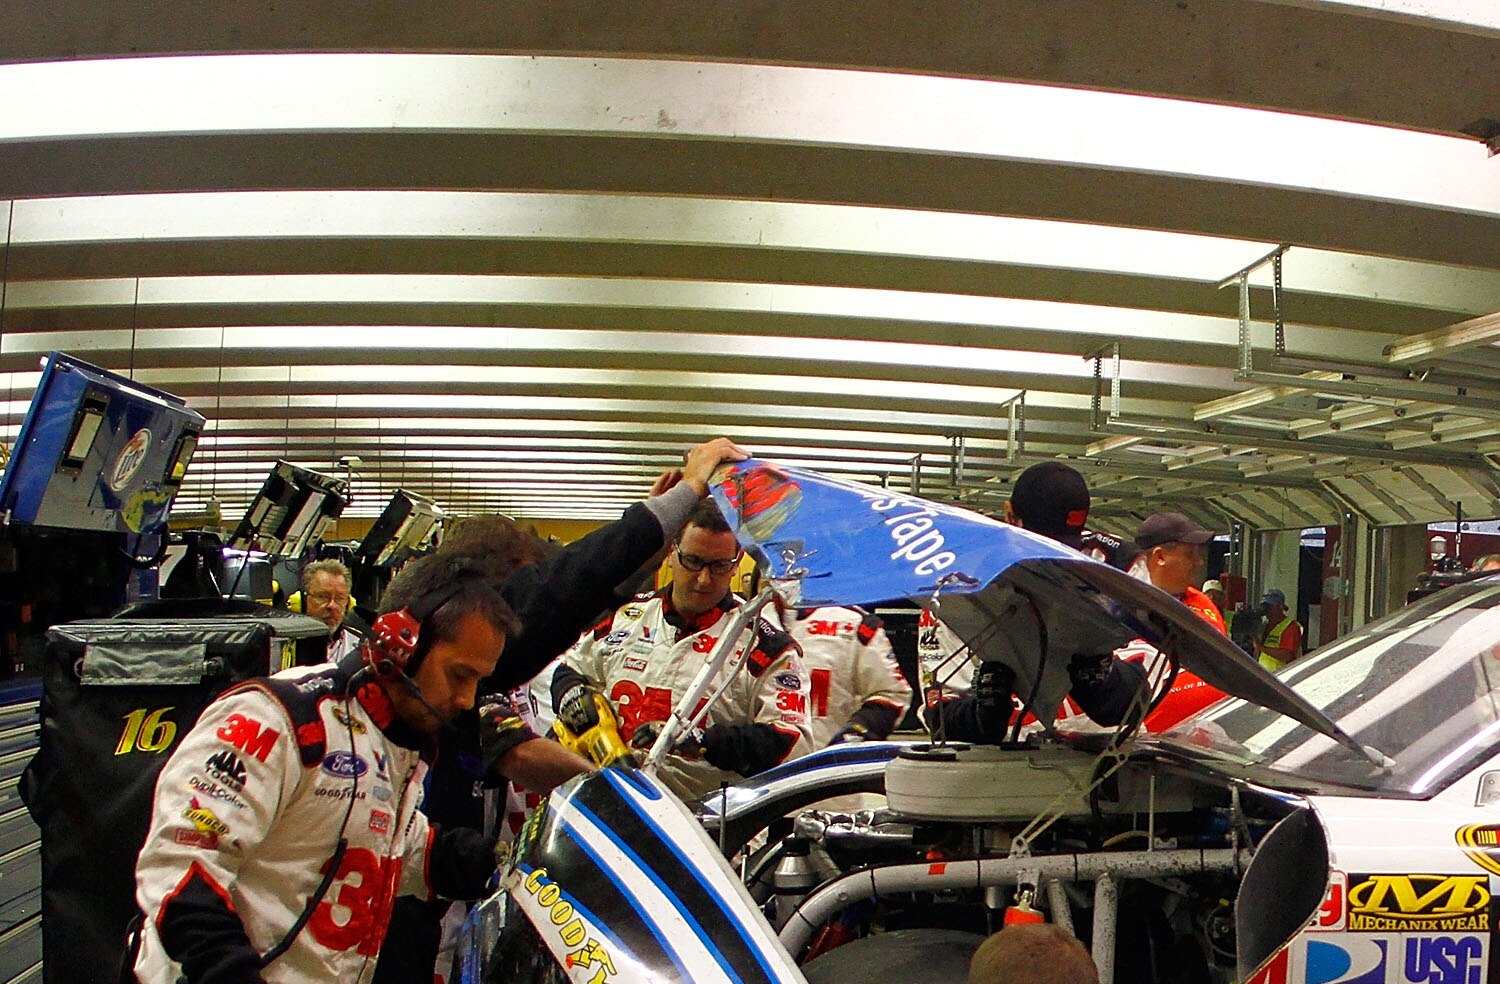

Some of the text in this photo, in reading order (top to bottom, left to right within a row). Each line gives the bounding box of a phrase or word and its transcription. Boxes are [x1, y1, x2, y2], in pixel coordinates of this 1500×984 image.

[776, 691, 806, 714] 3M
[113, 706, 178, 757] 16
[216, 713, 280, 763] 3M
[1348, 912, 1490, 931] MECHANIX WEAR
